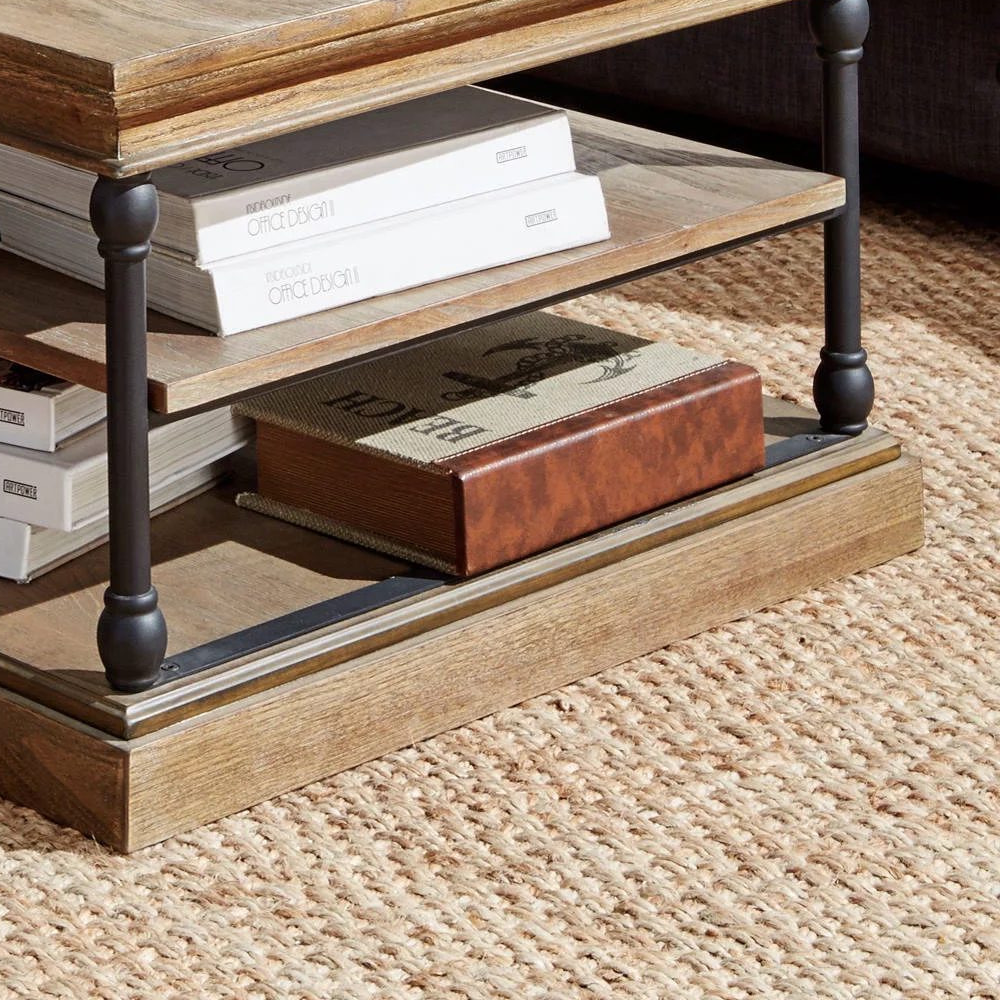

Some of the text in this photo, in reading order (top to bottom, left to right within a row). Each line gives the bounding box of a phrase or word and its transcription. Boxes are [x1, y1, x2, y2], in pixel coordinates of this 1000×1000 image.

[248, 212, 286, 236] OFFICE
[288, 200, 328, 228] DESIGN
[268, 279, 308, 305] OFFICE
[310, 268, 353, 295] DESIGN
